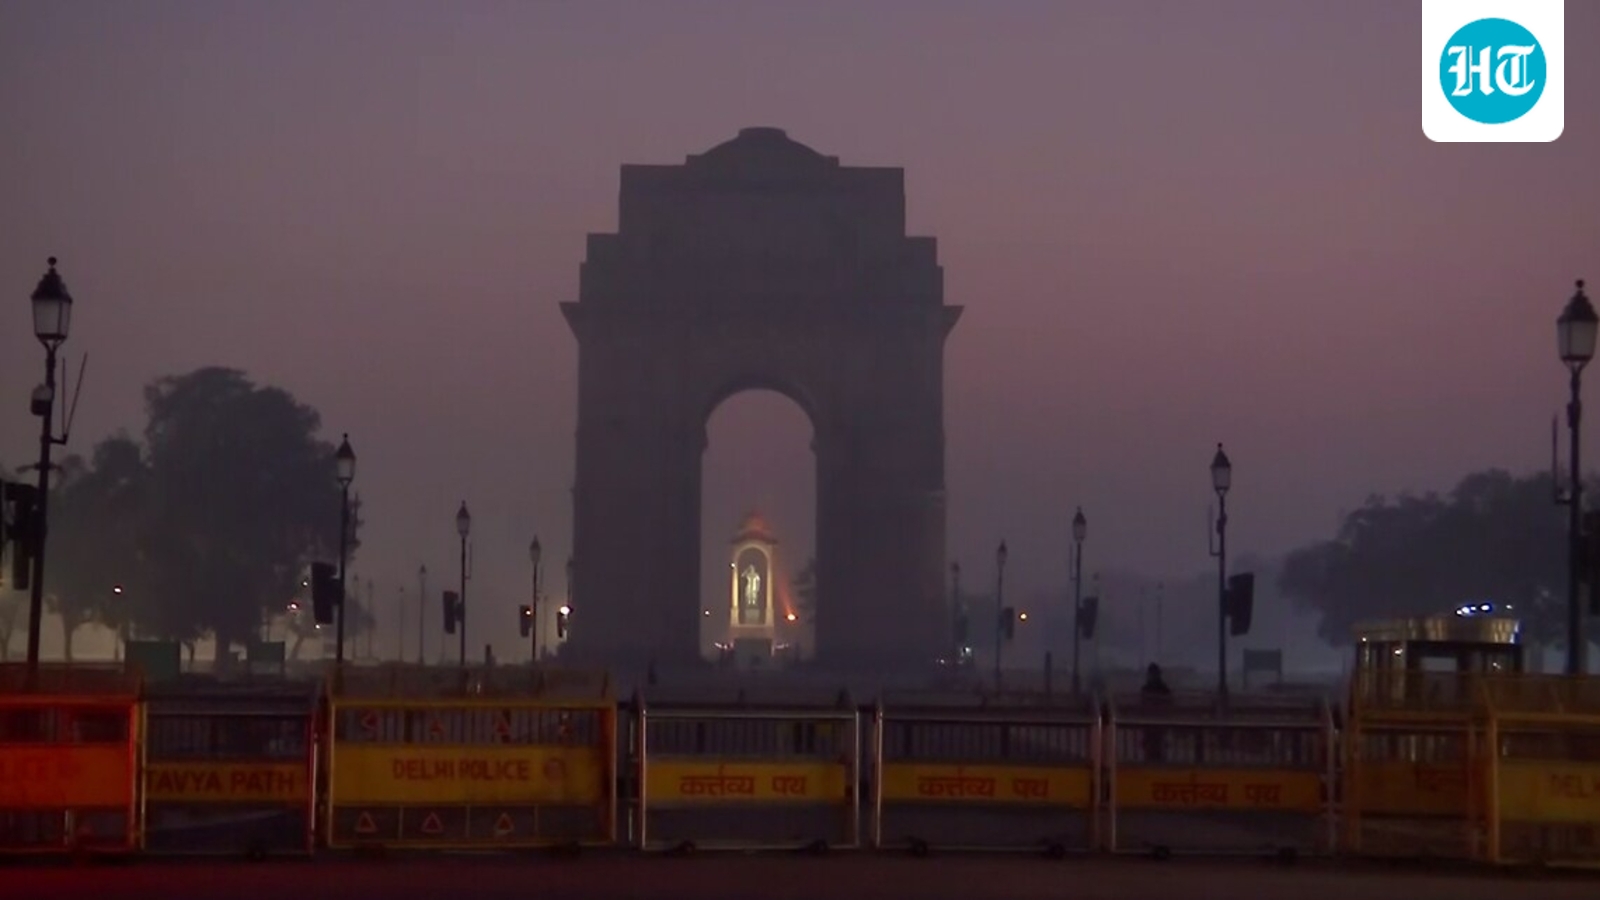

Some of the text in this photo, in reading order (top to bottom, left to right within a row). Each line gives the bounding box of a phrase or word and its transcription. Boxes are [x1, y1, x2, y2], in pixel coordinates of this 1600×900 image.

[393, 758, 531, 781] DELHI POLICE
[231, 770, 294, 794] PATH
[772, 777, 807, 795] पथ
